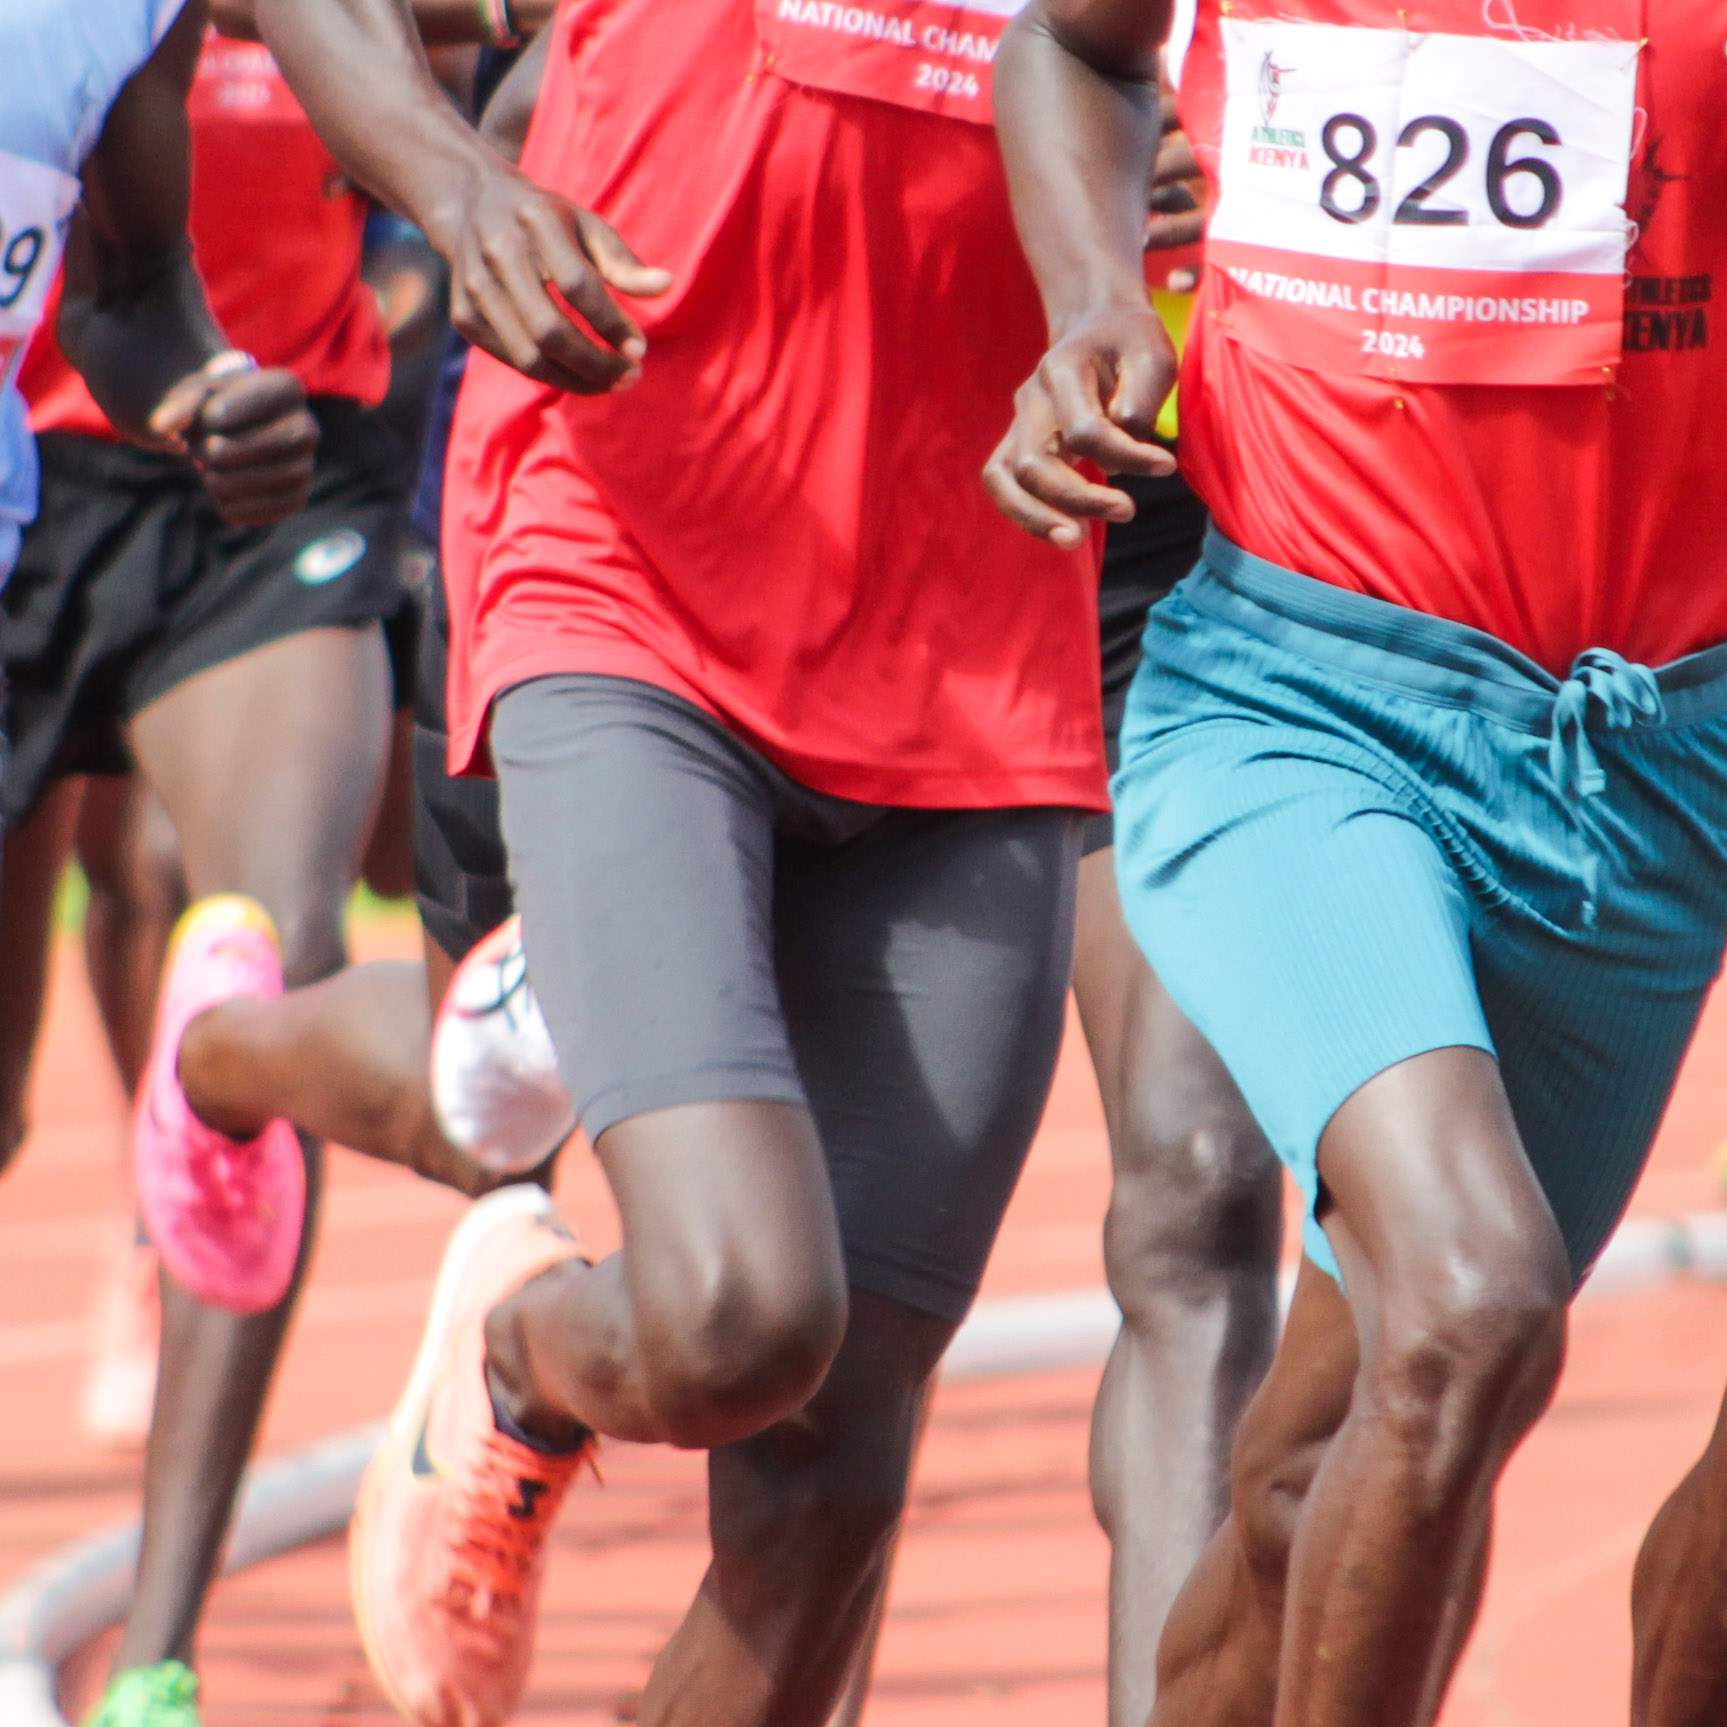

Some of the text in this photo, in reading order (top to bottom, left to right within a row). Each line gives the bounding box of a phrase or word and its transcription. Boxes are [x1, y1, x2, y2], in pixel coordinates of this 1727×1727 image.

[914, 62, 980, 98] 2024
[1248, 146, 1310, 170] KENYA
[1320, 113, 1564, 230] 826
[1361, 288, 1590, 324] CHAMPIONSHIP
[1360, 329, 1425, 359] 2024
